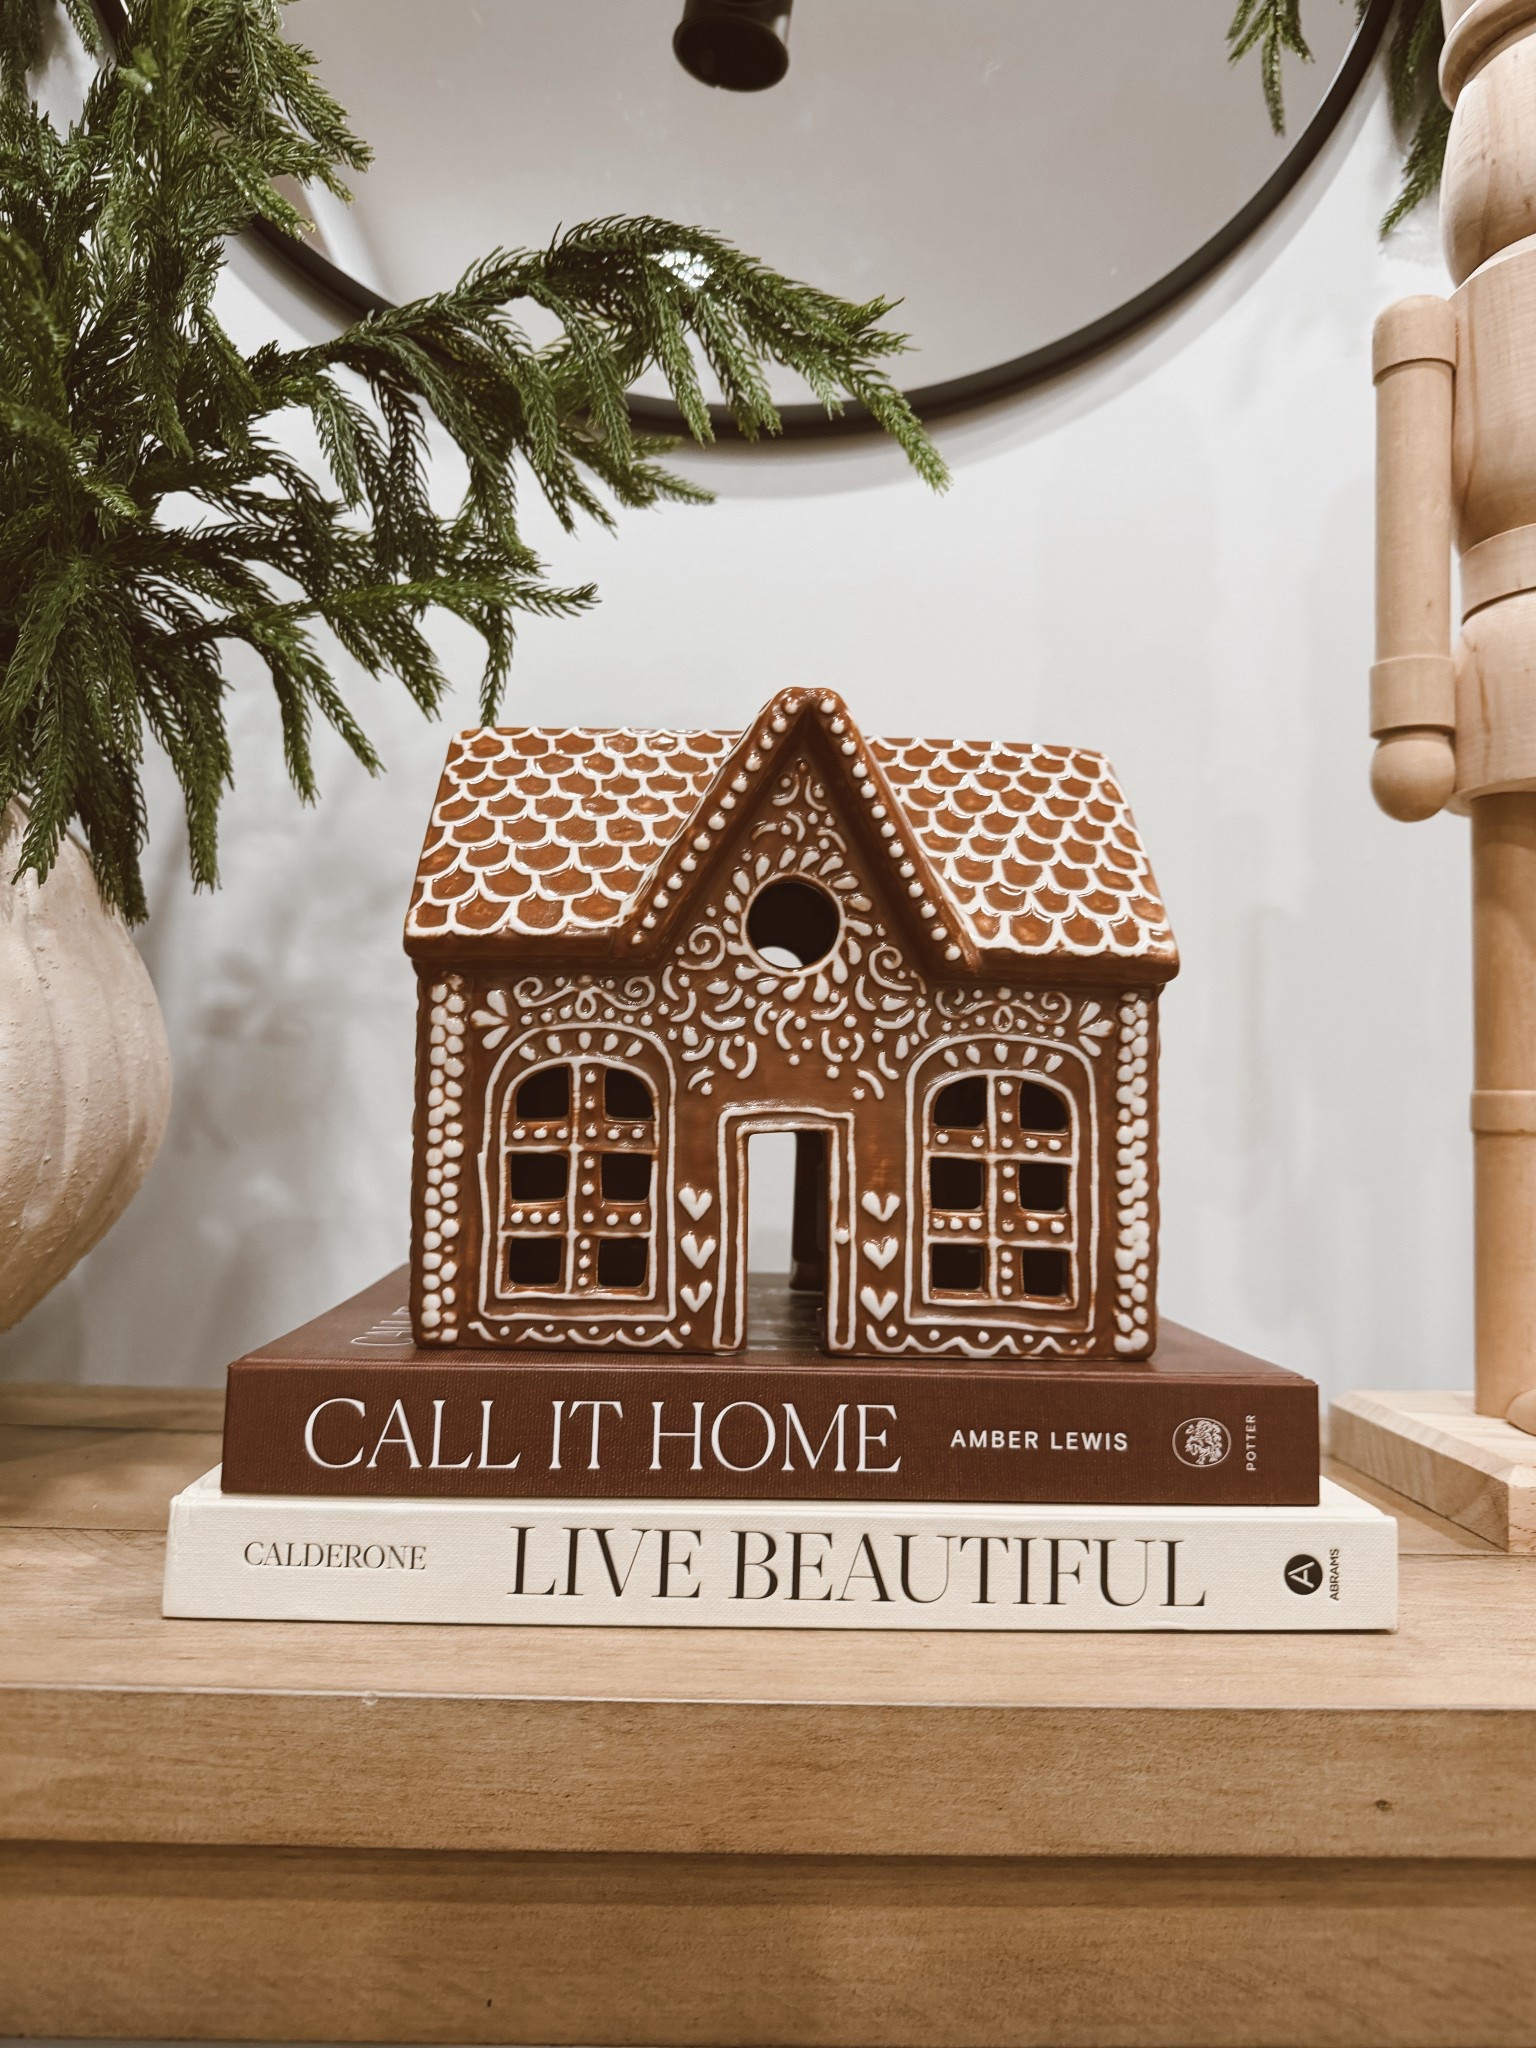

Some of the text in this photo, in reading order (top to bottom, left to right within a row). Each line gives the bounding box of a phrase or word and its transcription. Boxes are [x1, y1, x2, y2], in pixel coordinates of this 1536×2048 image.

[303, 1398, 902, 1475] CALL IT HOME
[949, 1429, 1129, 1453] AMBER LEWIS
[1245, 1413, 1257, 1472] POTTER
[243, 1541, 427, 1571] CALDERONE
[506, 1525, 1208, 1607] LIVE BEAUTIFUL
[1329, 1548, 1340, 1602] ABRAMS
